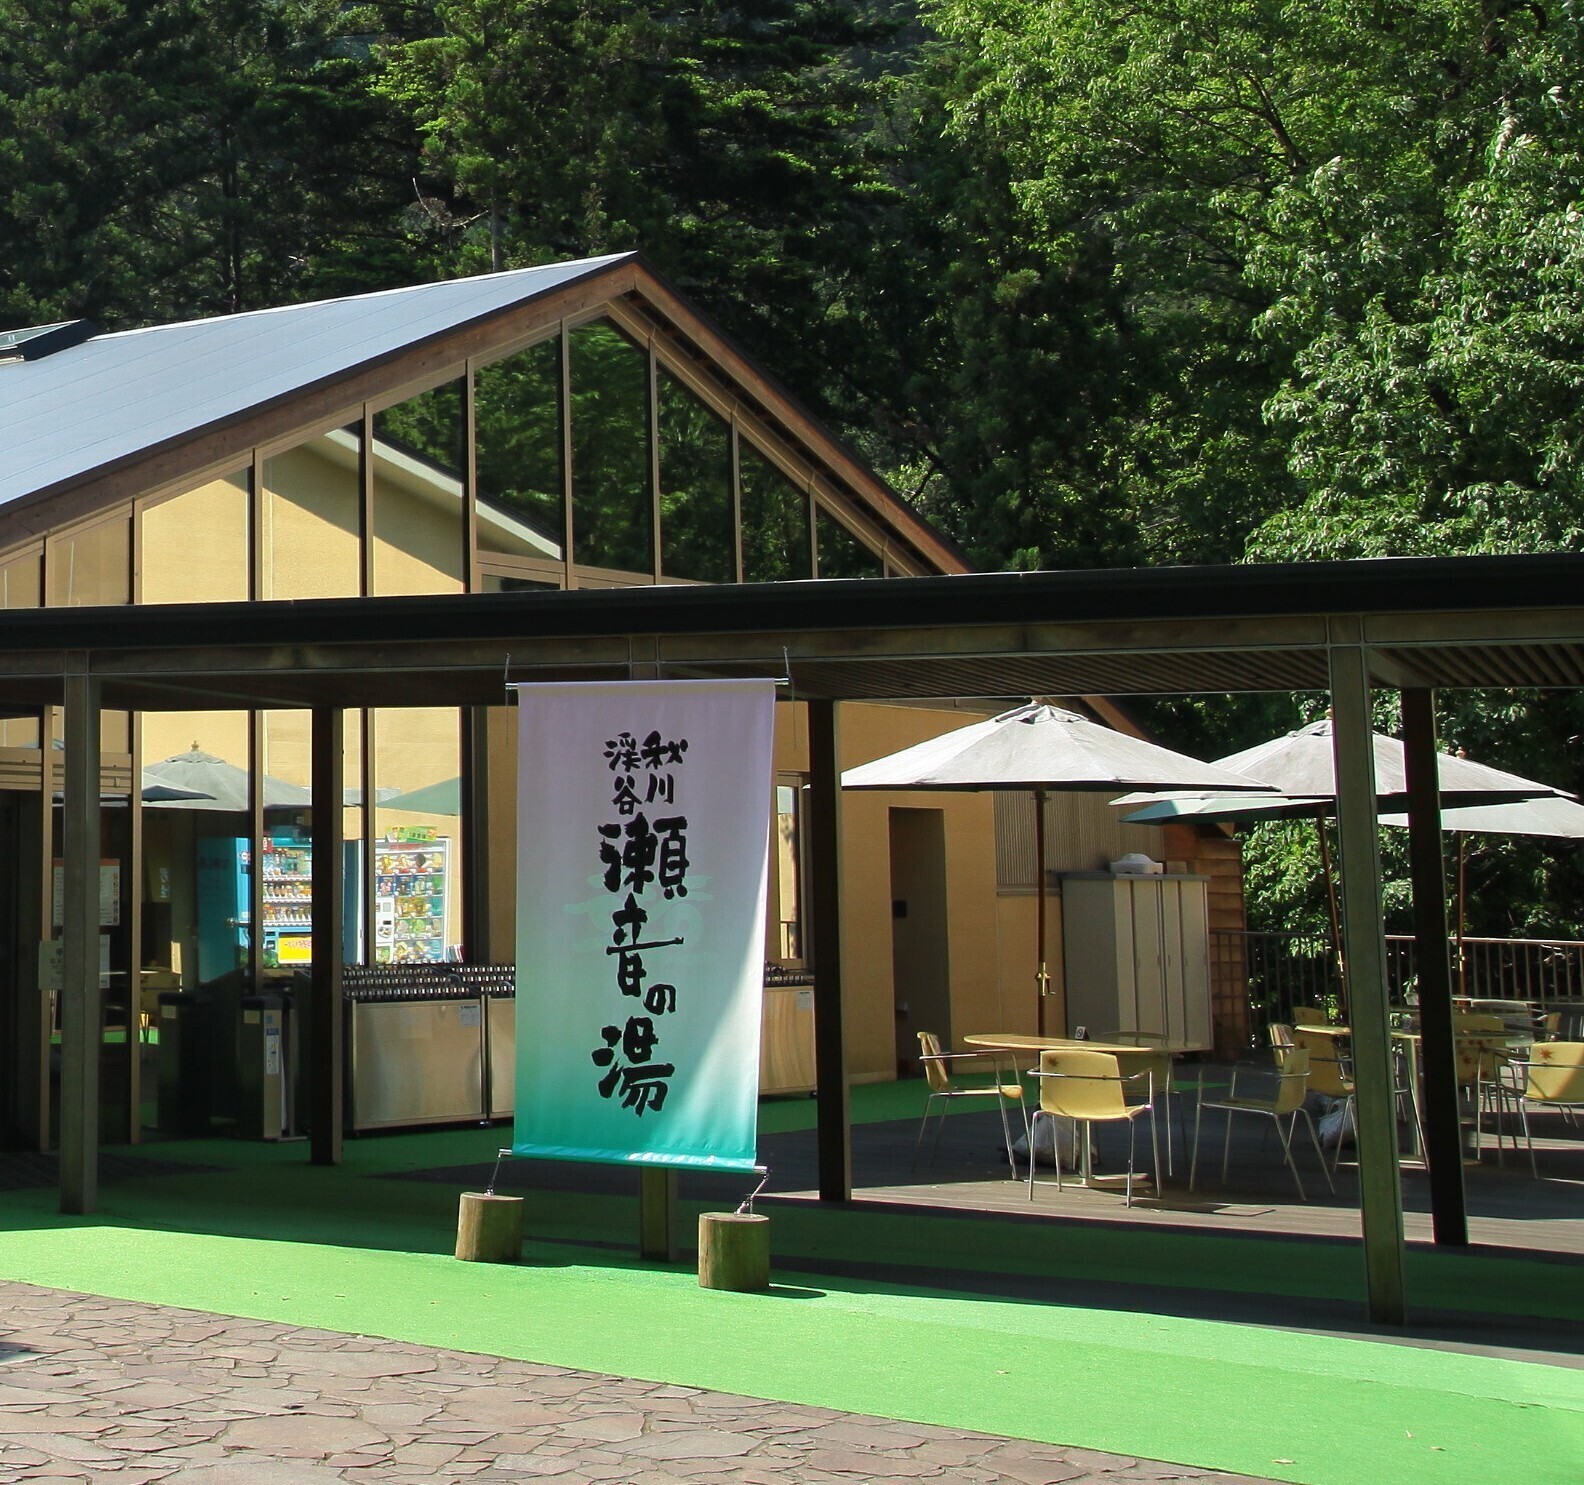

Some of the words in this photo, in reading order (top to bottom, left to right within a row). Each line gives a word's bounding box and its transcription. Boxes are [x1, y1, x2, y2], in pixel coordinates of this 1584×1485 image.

[640, 730, 689, 805] 秋川
[591, 812, 690, 1118] 瀬音の湯
